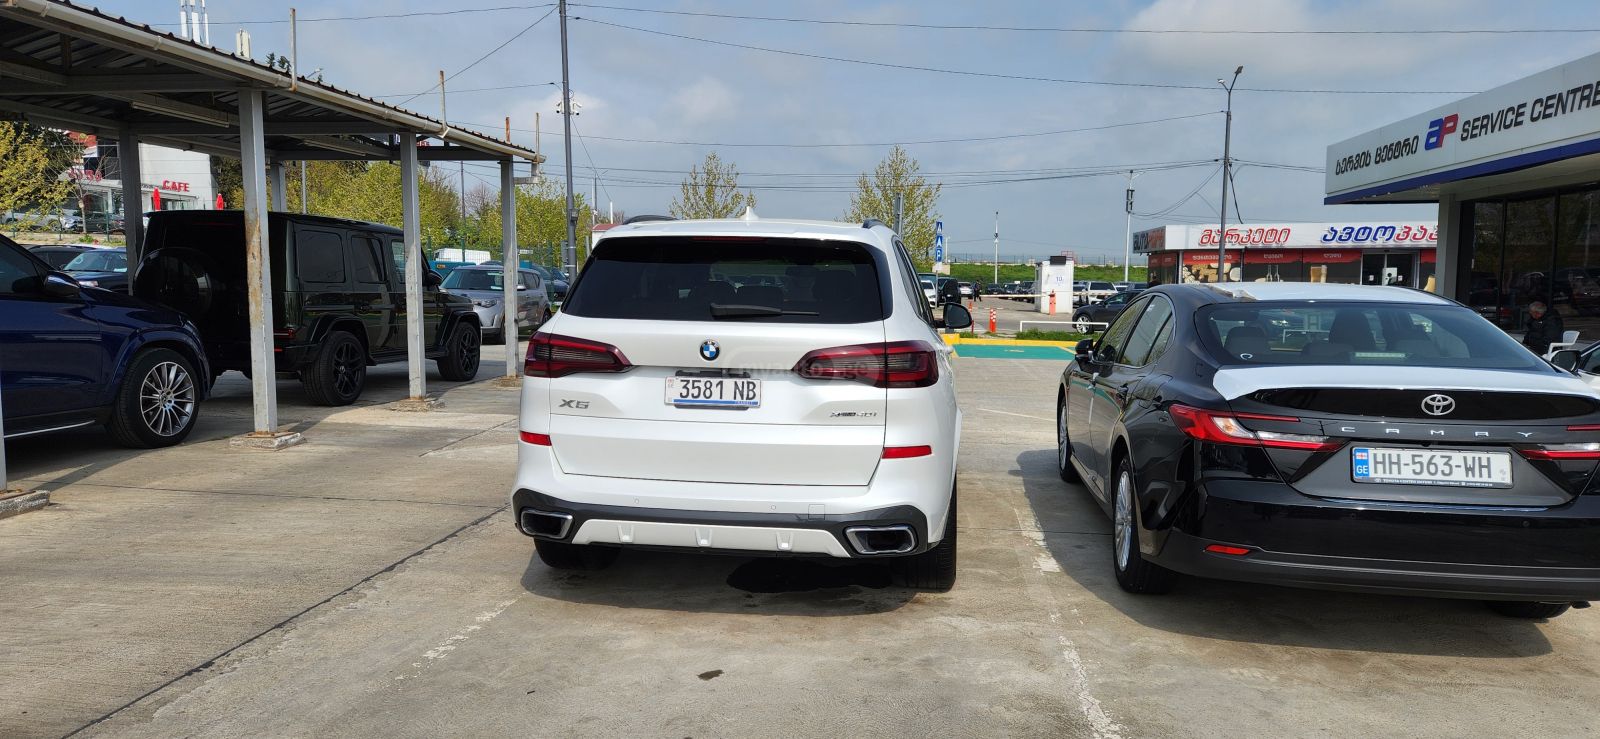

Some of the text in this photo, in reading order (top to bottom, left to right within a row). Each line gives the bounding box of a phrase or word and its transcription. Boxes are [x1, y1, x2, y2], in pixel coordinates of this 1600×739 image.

[1460, 102, 1527, 142] SERVICE
[1529, 82, 1600, 123] CENTRE
[1335, 135, 1419, 175] სერვის ცენტრი
[162, 180, 190, 192] CAFE
[679, 379, 757, 401] 3581 NB
[1356, 452, 1493, 479] GE HH-563-WH
